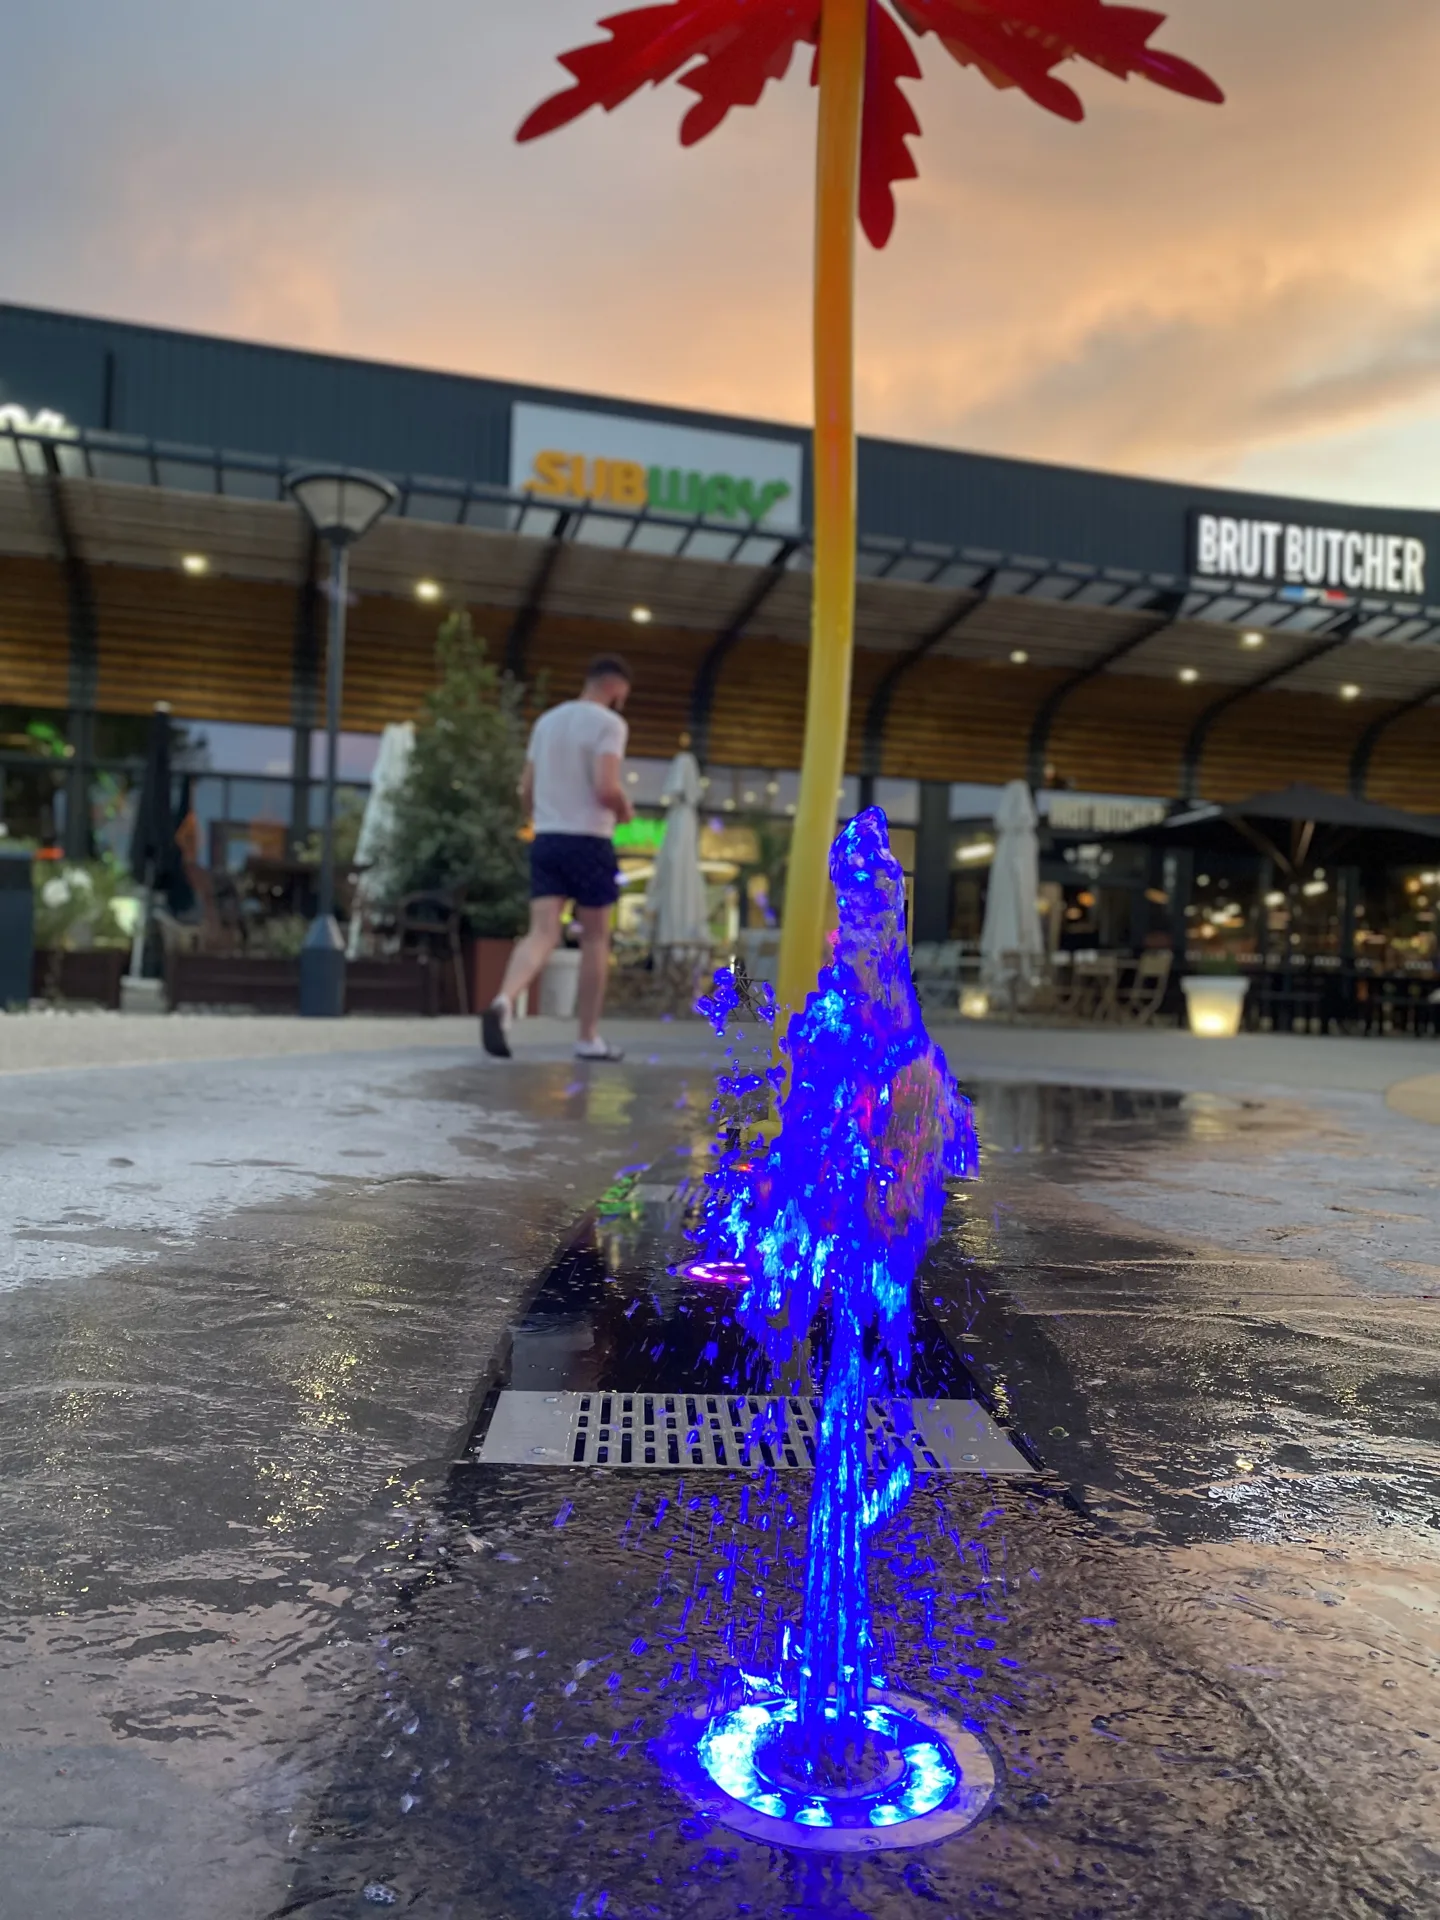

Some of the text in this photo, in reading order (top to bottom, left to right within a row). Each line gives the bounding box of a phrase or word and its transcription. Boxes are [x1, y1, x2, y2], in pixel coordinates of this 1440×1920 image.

[524, 449, 791, 521] SUBWAY
[1198, 514, 1426, 595] BRUT BUTCHER
